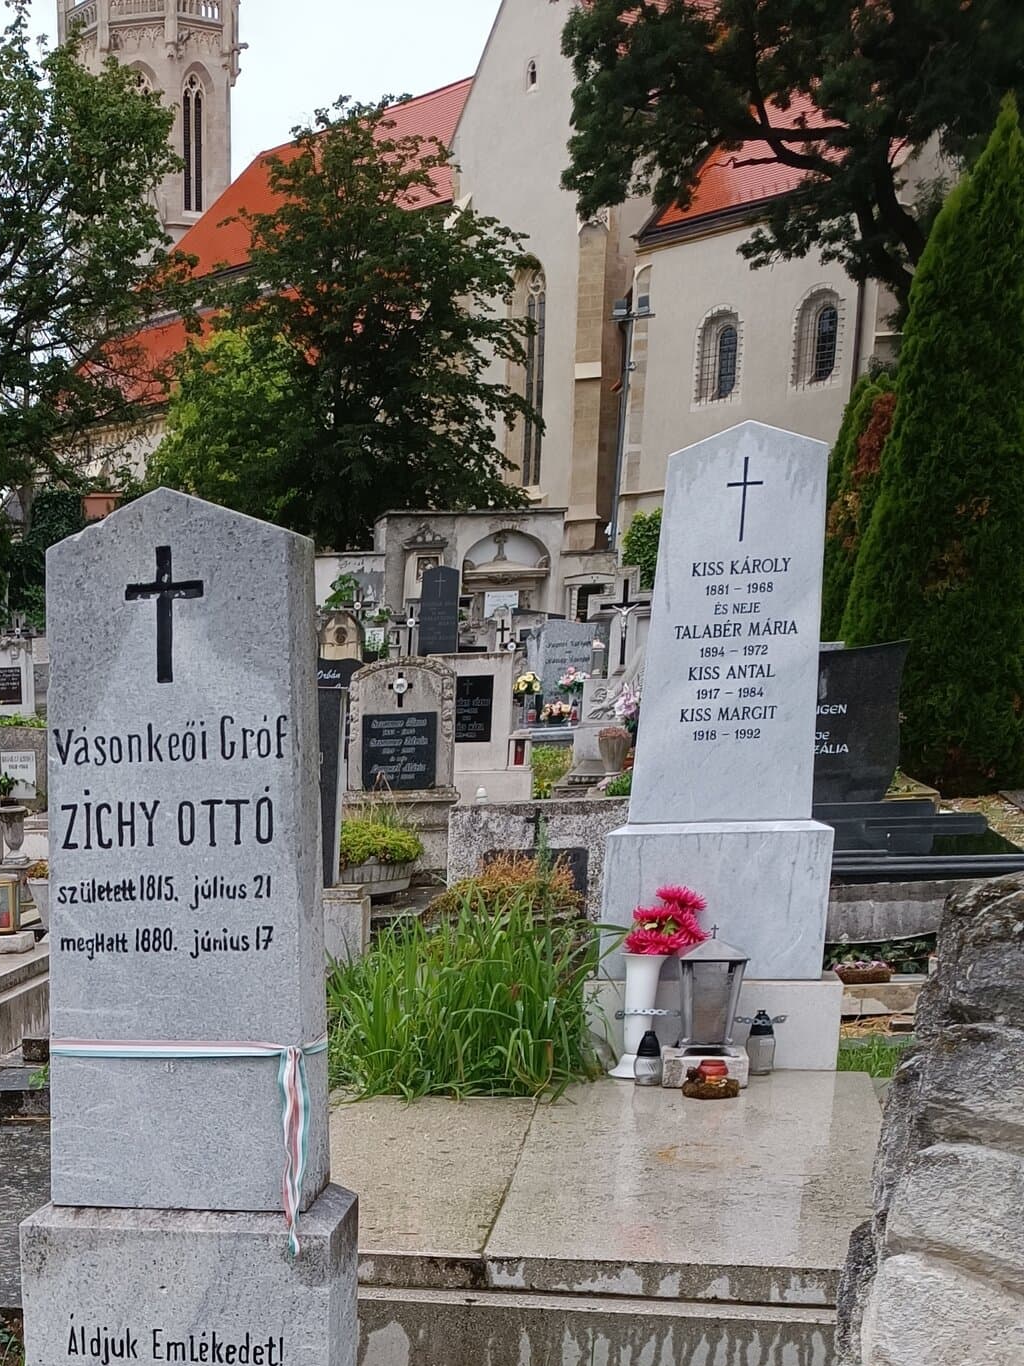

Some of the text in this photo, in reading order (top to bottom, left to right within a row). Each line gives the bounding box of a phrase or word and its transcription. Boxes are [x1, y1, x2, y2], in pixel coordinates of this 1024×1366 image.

[691, 556, 792, 577] KISS KÁROLY
[706, 584, 730, 596] 1881
[747, 581, 774, 594] 1968
[714, 602, 761, 615] ÉS NEJE
[675, 618, 798, 640] TALABÉR MÁRIA
[700, 646, 725, 658] 1894
[743, 645, 769, 657] 1972
[688, 664, 776, 681] KISS ANTAL
[696, 688, 720, 700] 1917
[738, 687, 764, 699] 1984
[680, 705, 778, 722] KISS MARGIT
[220, 715, 287, 761] Gróf
[693, 730, 717, 741] 1918
[735, 728, 761, 740] 1992
[178, 786, 274, 847] OTTÓ
[57, 875, 272, 910] született 1815. július 21
[135, 927, 178, 953] 1880.
[189, 928, 250, 959] június
[255, 925, 274, 951] 17
[67, 1313, 139, 1366] Áldjuk
